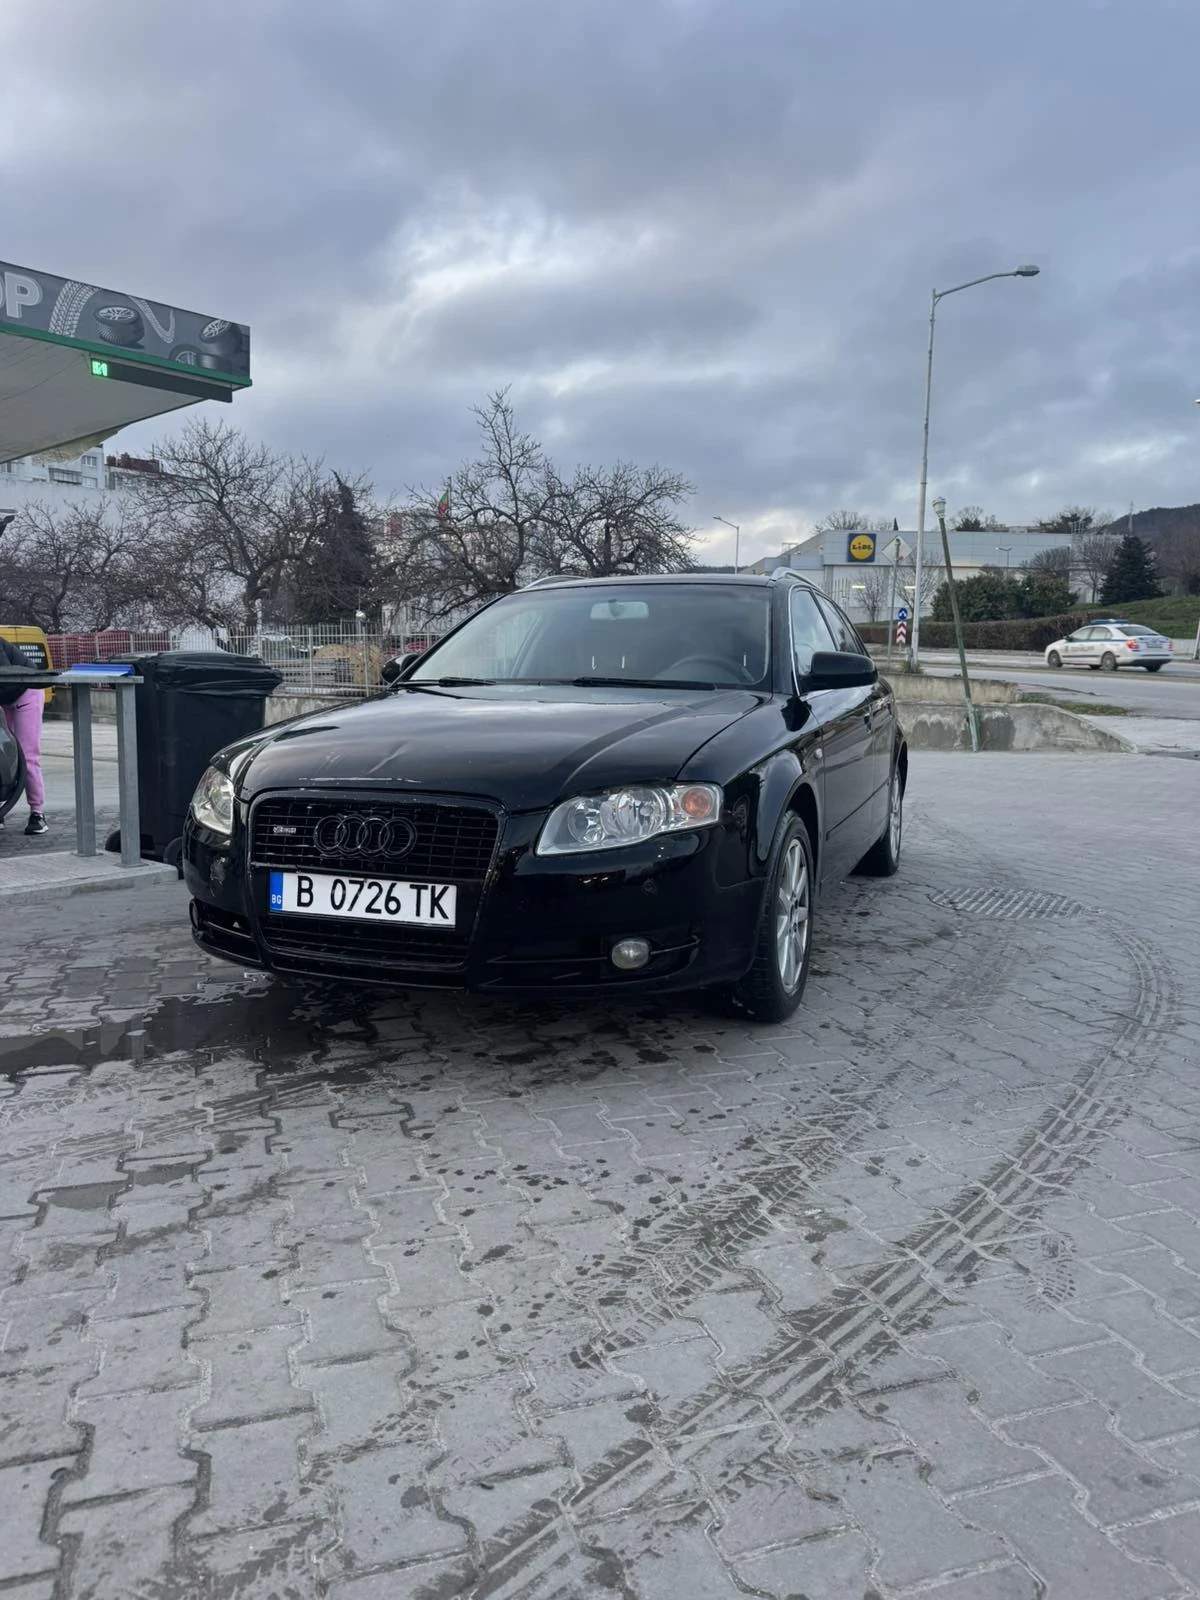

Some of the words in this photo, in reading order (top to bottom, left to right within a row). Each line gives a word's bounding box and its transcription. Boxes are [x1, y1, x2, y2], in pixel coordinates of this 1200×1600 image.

[0, 272, 43, 318] P
[271, 894, 282, 905] BG
[296, 875, 314, 908] B
[330, 878, 402, 915] 0726
[409, 883, 450, 919] TK
